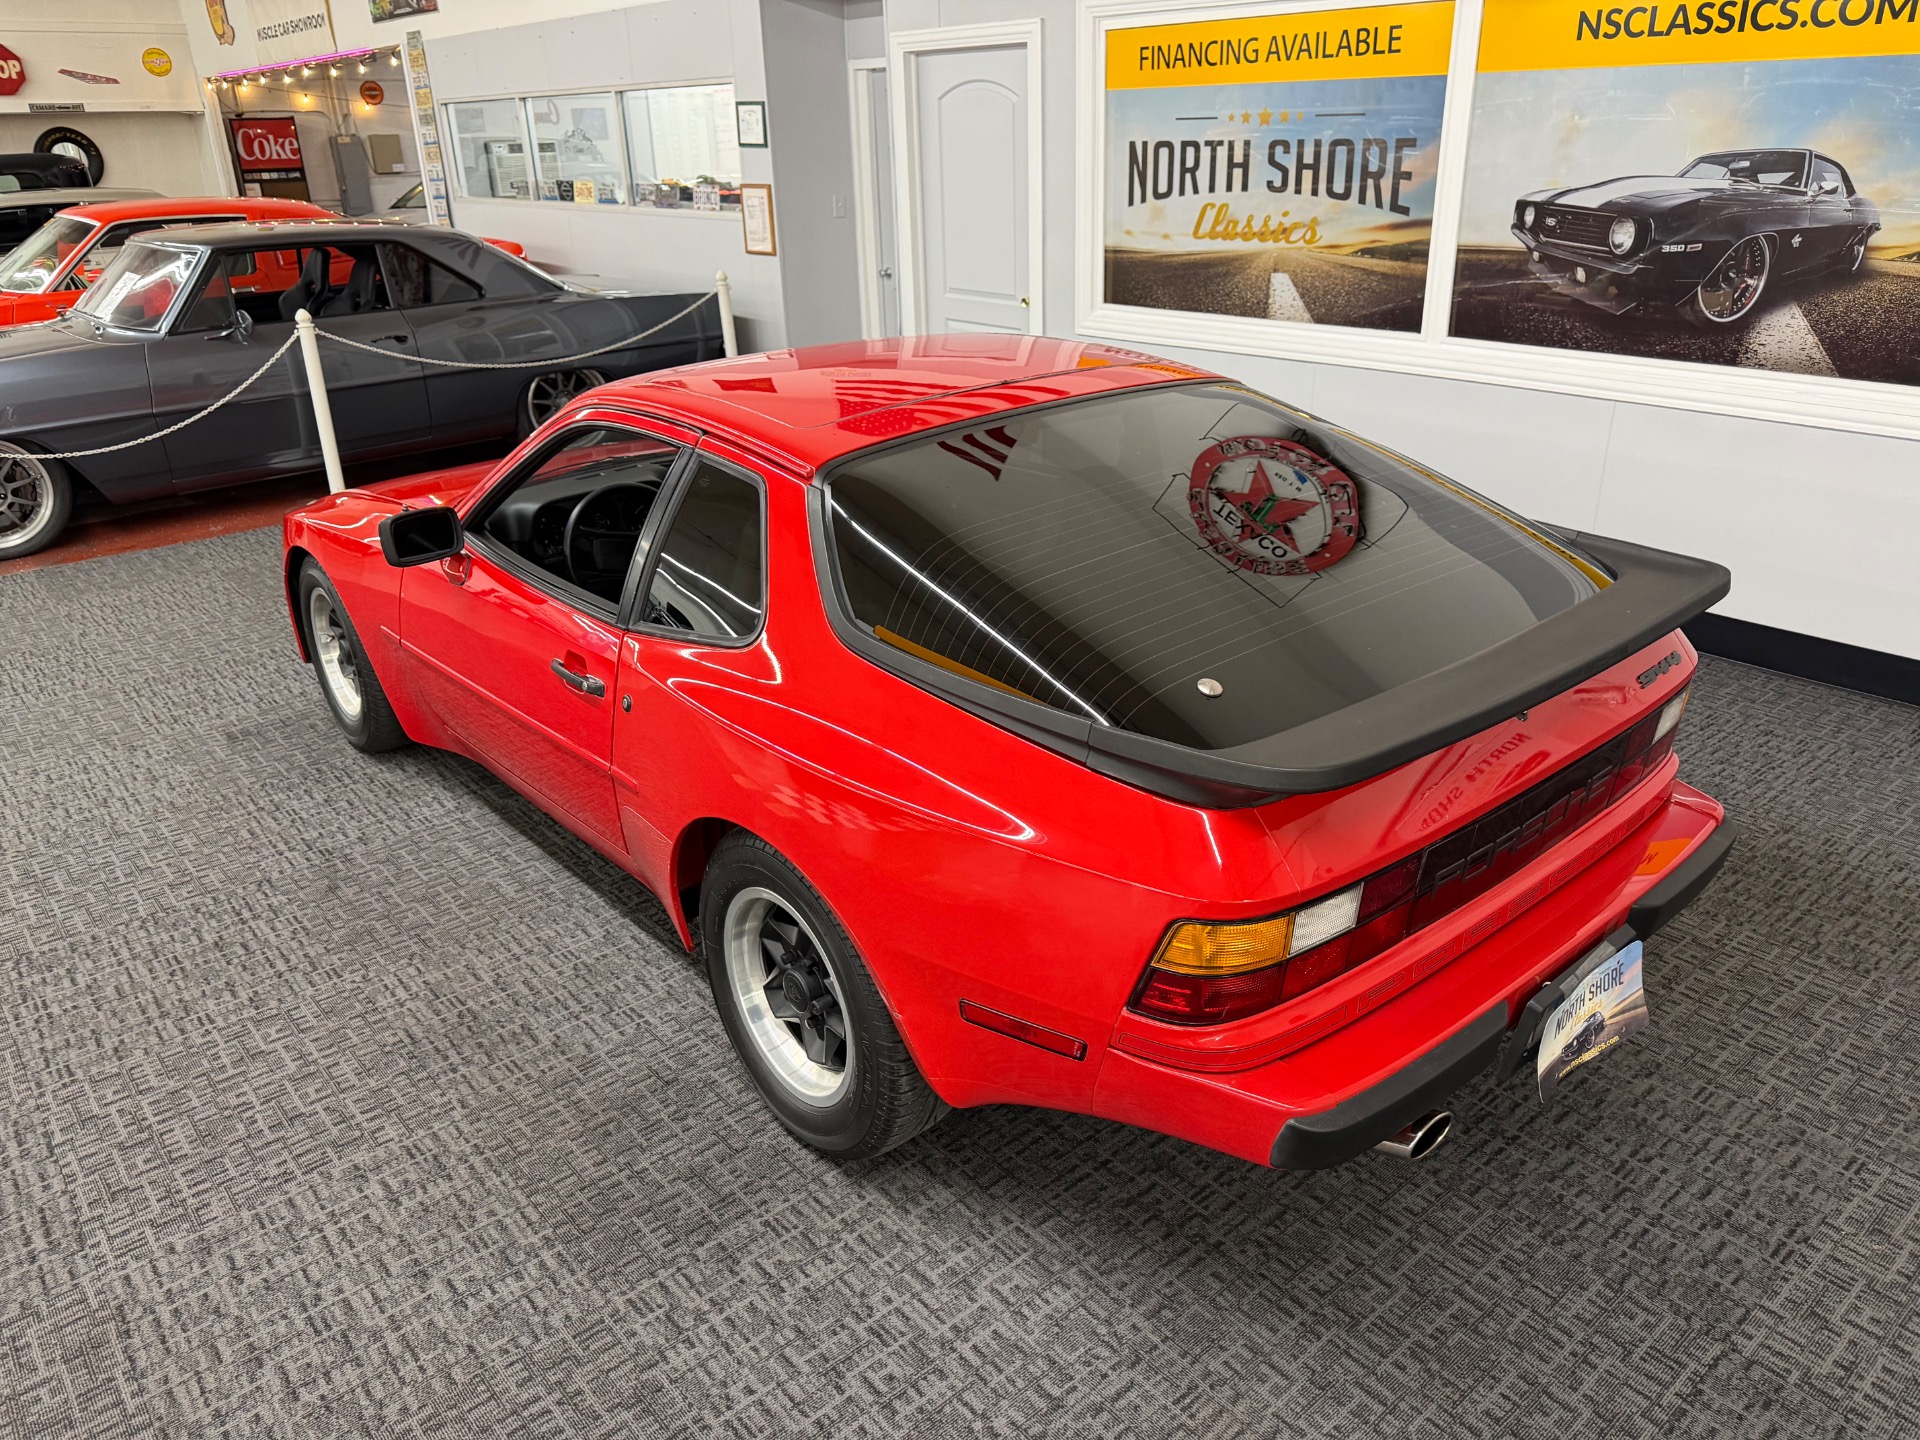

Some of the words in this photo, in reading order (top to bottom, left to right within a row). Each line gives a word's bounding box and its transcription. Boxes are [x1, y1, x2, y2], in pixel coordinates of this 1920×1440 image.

[278, 20, 291, 36] CAR
[1576, 0, 1918, 41] NSCLASSICS.COM
[1139, 36, 1259, 71] FINANCING
[1265, 24, 1403, 63] AVAILABLE
[0, 60, 21, 79] OP
[237, 128, 300, 161] Coke
[1128, 139, 1252, 208] NORTH
[1266, 137, 1418, 217] SHORE
[1192, 202, 1323, 246] Classics
[1661, 244, 1685, 253] 350
[1554, 990, 1587, 1040] NORTH
[1588, 961, 1624, 1002] SHORE
